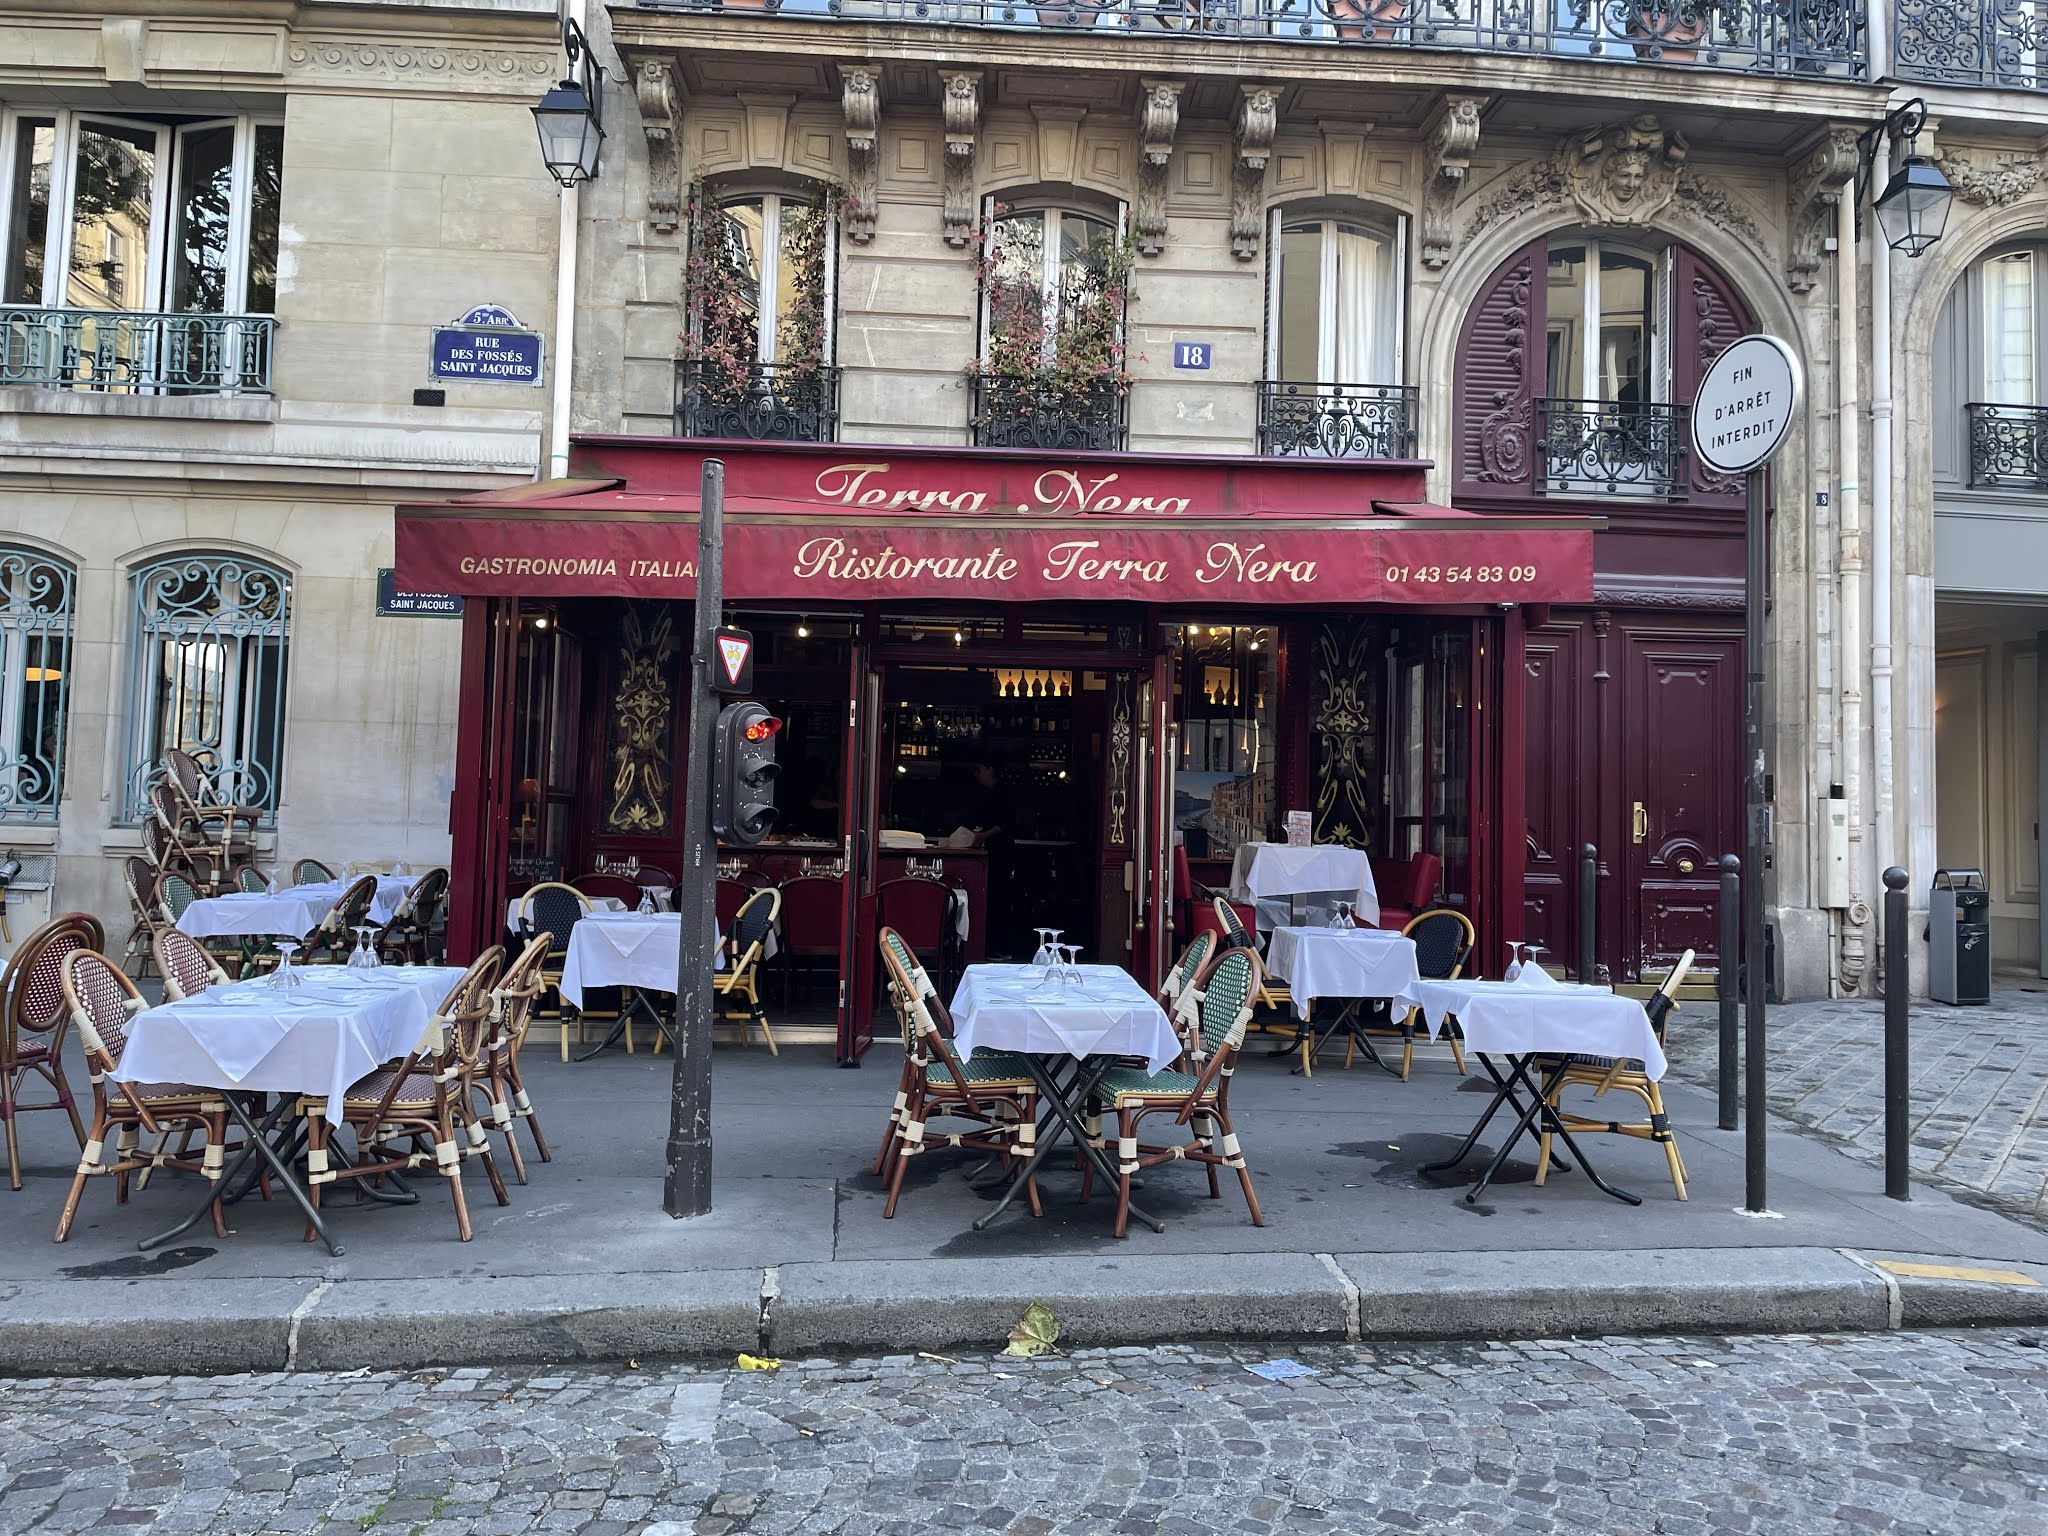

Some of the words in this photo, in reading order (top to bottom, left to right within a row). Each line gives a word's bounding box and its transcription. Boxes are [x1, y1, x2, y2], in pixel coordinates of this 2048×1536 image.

[475, 337, 500, 348] RUE
[451, 349, 473, 359] DES
[477, 350, 523, 362] FOSSÉS
[1182, 346, 1203, 366] 18
[440, 361, 476, 372] SAINT
[479, 363, 532, 376] JACQUES
[1733, 366, 1752, 384] FIN
[1715, 391, 1771, 420] D'ARRÊT
[1711, 419, 1774, 449] INTERDIT
[815, 463, 989, 512] Terra
[1016, 469, 1192, 516] Nera
[460, 556, 617, 576] GASTRONOMIA
[629, 560, 698, 578] ITALIA
[793, 537, 1018, 581] Ristorante
[1042, 540, 1170, 583] Terra
[1195, 542, 1318, 584] Nera
[1386, 566, 1409, 583] 01
[1414, 566, 1441, 583] 43
[1446, 566, 1472, 583] 54
[1476, 566, 1504, 583] 83
[1508, 566, 1537, 583] 09
[390, 600, 414, 609] SAINT
[416, 600, 455, 610] JACQUES
